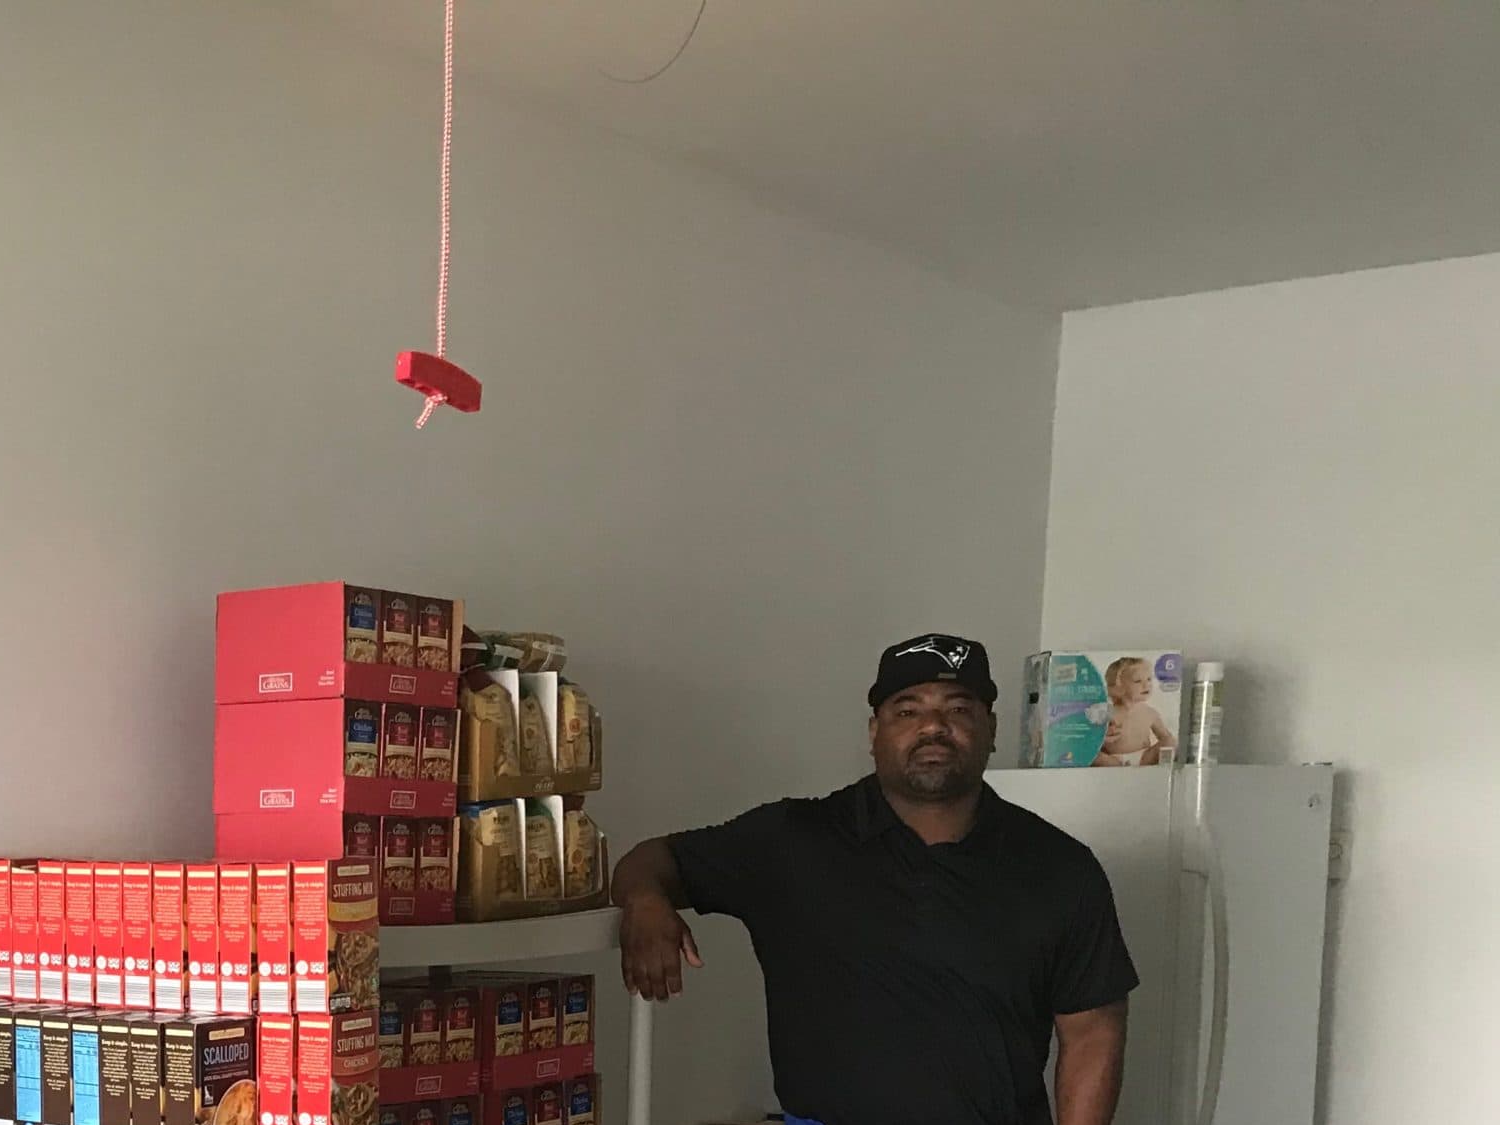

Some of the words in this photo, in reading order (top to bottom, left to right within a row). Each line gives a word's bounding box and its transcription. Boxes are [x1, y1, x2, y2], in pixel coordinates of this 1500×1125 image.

[333, 883, 361, 898] STUFFING
[363, 882, 373, 895] MIX
[337, 1037, 363, 1053] STUFFING
[364, 1034, 375, 1047] MIX
[203, 1043, 249, 1066] SCALLOPED
[343, 1056, 370, 1068] CHICKEN
